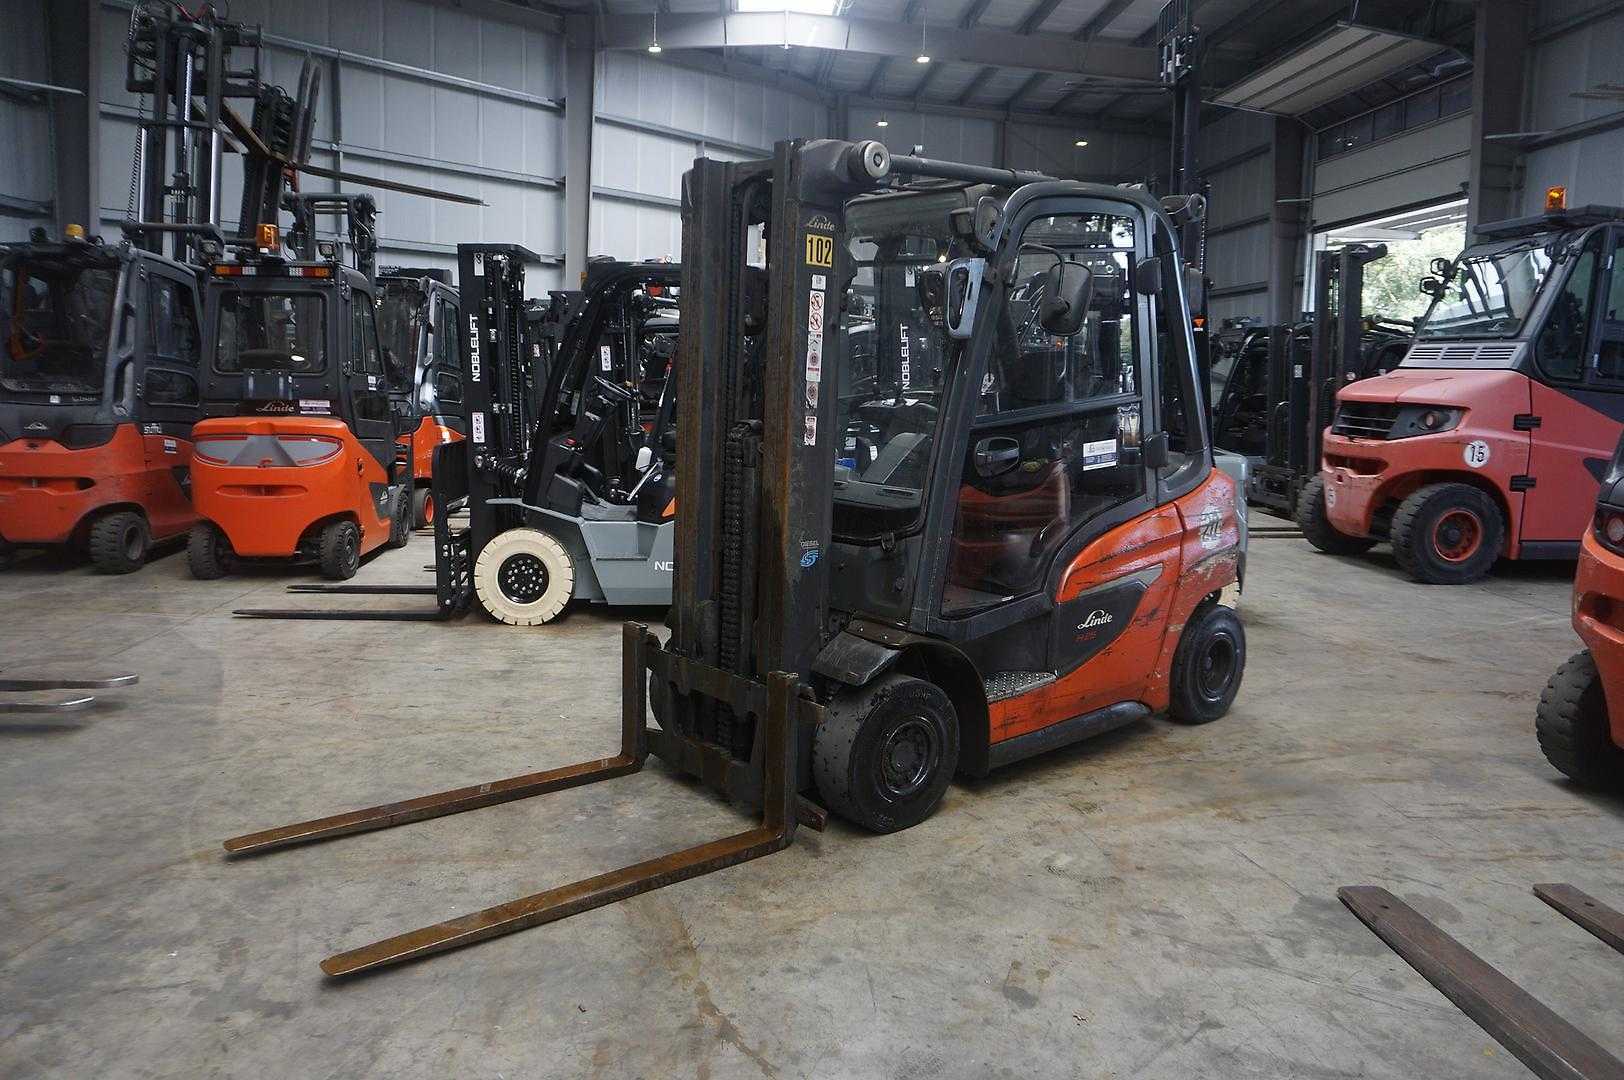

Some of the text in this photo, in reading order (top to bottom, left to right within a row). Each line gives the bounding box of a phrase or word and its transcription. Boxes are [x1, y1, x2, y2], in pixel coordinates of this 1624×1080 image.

[806, 215, 835, 231] Linde
[808, 237, 832, 265] 102
[469, 313, 481, 382] NOBLELIFT
[900, 323, 911, 390] NOBLELIFT
[255, 400, 295, 412] Linde
[1470, 444, 1485, 463] 15
[1077, 609, 1113, 630] Linde
